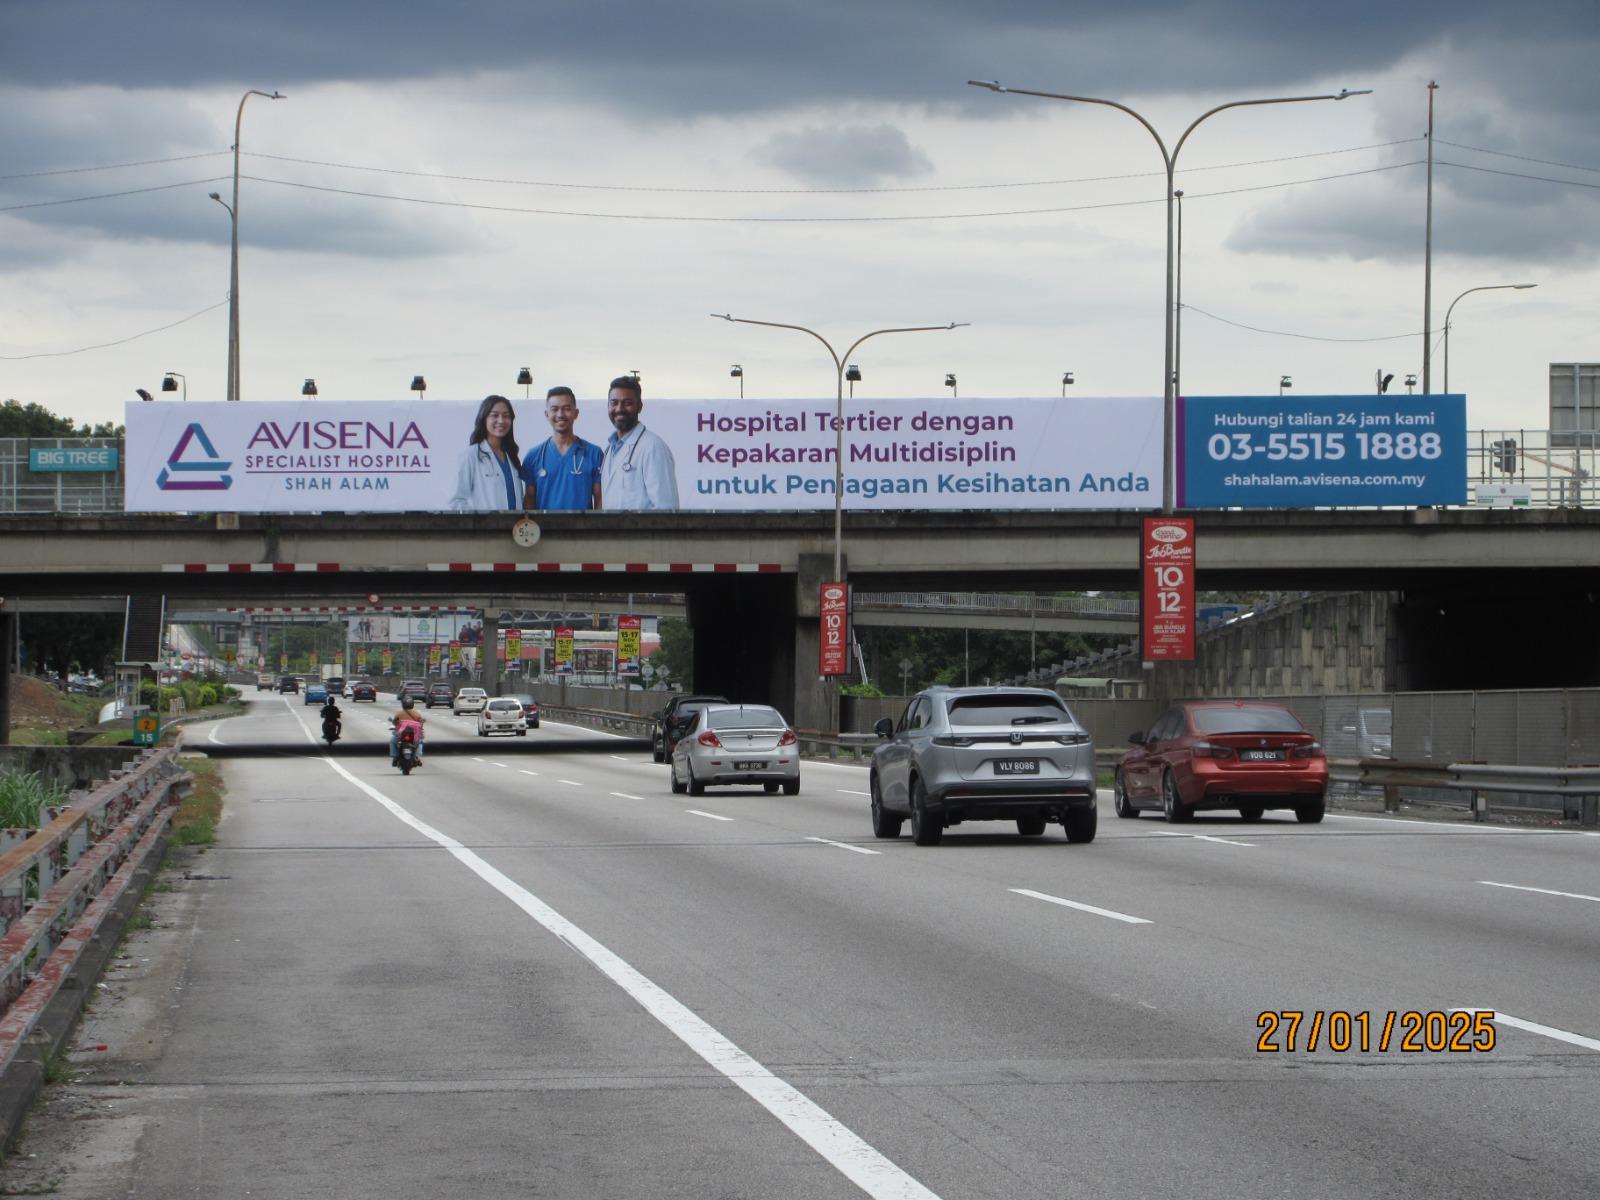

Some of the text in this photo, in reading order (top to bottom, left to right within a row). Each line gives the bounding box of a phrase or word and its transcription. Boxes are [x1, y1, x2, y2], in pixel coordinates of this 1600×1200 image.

[698, 411, 1013, 436] Hospital Tertier dengan
[1214, 411, 1435, 429] Hubungi talian 24 jam kami
[247, 420, 429, 449] AVISENA
[698, 441, 1016, 467] Kepakaran Multidisiplin
[1207, 431, 1442, 460] 03-5515 1888
[38, 451, 109, 464] BIG TREE
[246, 455, 431, 468] SPECIALIST HOSPITAL
[285, 477, 390, 490] SHAH ALAM
[698, 472, 1150, 498] untuk Penjagaan Kesihatan Anda
[1223, 472, 1426, 488] shahalam.avisena.com.my
[1154, 567, 1184, 587] 10
[1157, 592, 1181, 612] 12
[826, 615, 840, 628] 10
[827, 631, 839, 644] 12
[140, 733, 153, 742] 15
[999, 762, 1013, 770] VLY
